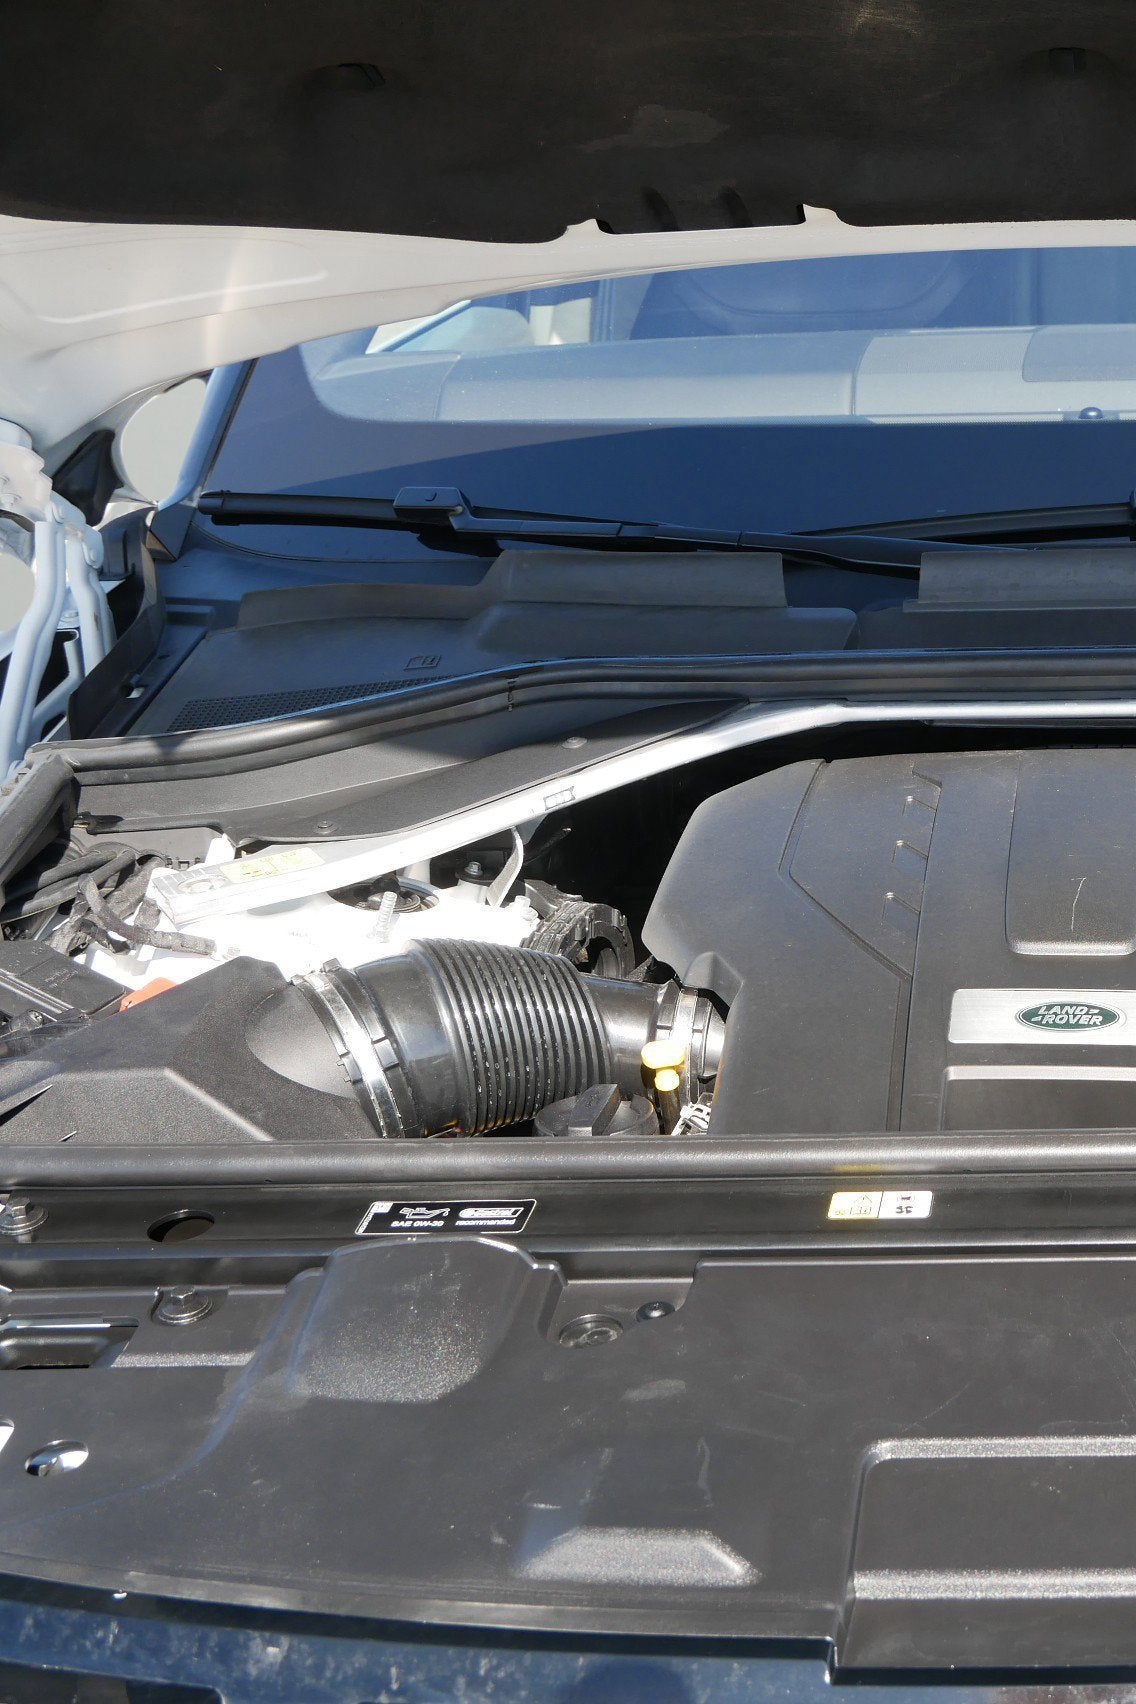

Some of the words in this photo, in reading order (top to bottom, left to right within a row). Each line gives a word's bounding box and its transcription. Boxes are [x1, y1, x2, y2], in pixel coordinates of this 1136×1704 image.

[1037, 1006, 1087, 1015] LAND
[1041, 1014, 1103, 1025] ROVER
[455, 1218, 516, 1226] recommended
